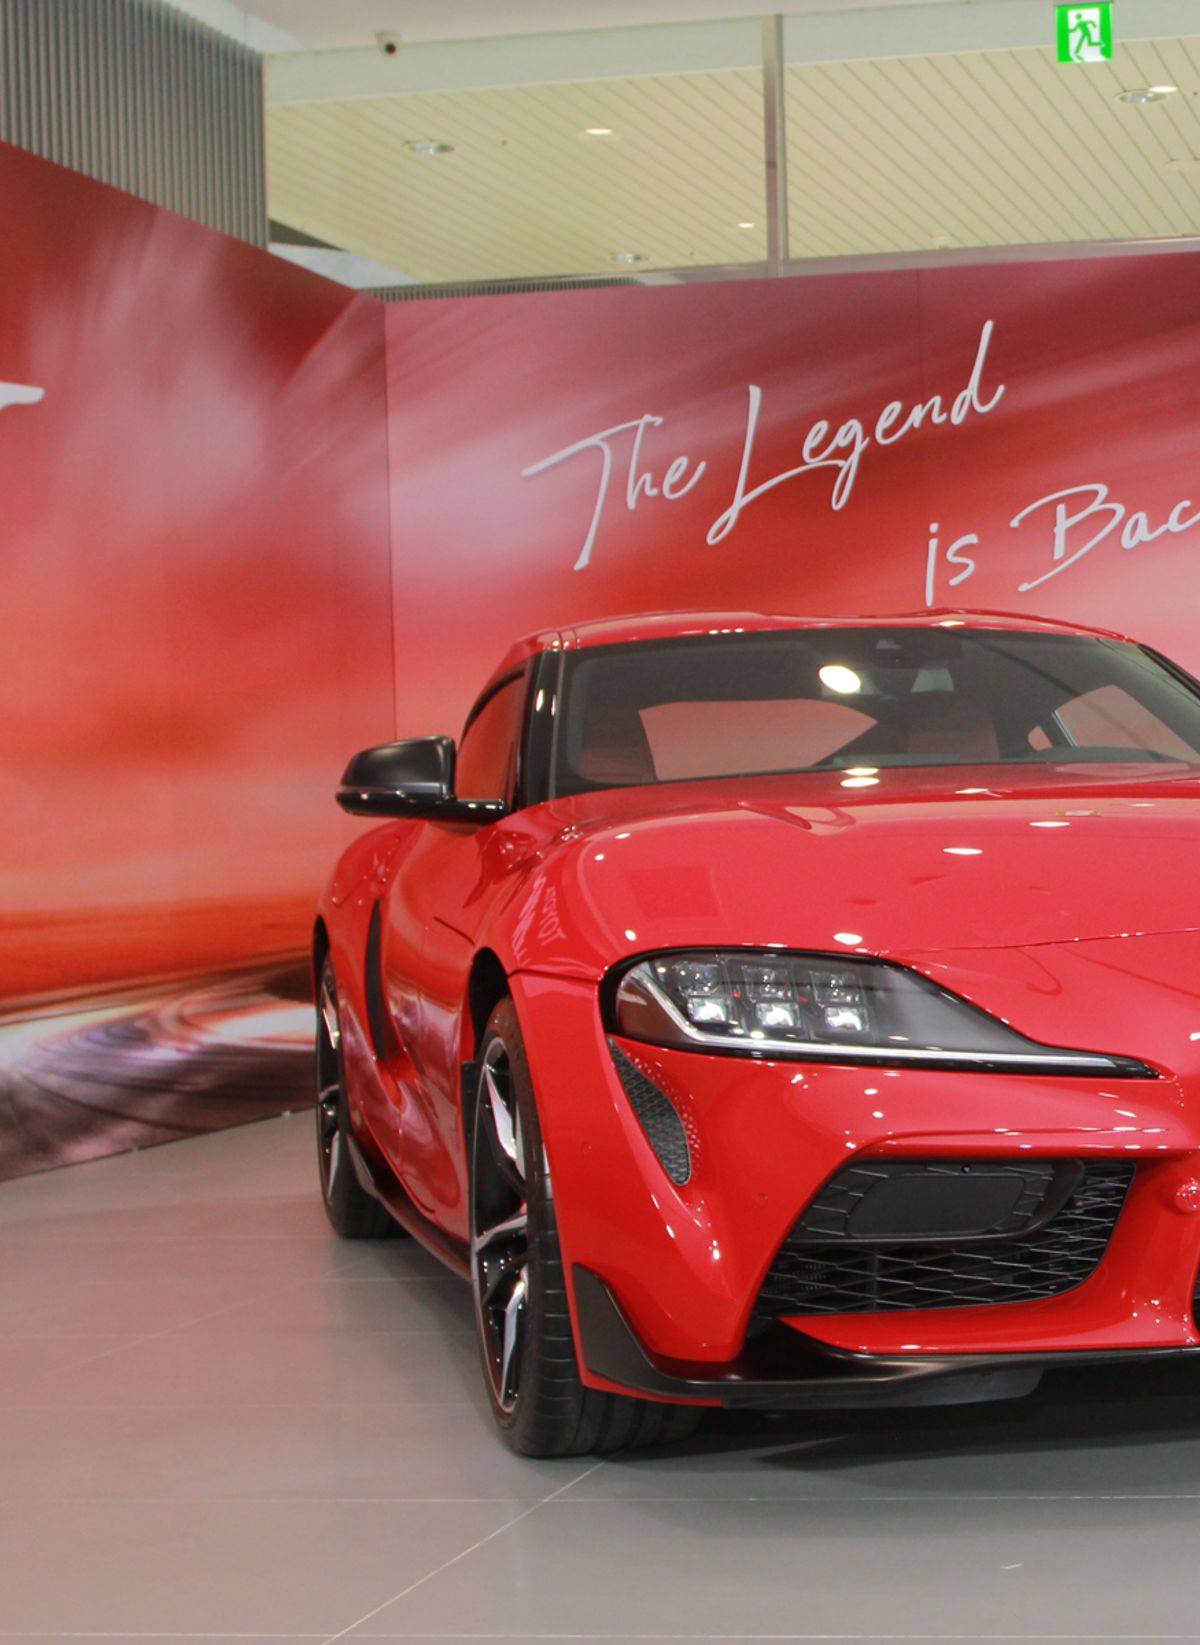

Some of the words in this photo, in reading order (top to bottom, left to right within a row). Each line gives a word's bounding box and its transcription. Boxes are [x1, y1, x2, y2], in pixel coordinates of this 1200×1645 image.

[521, 414, 706, 571] The
[706, 319, 1006, 547] Legend
[925, 523, 979, 607] is
